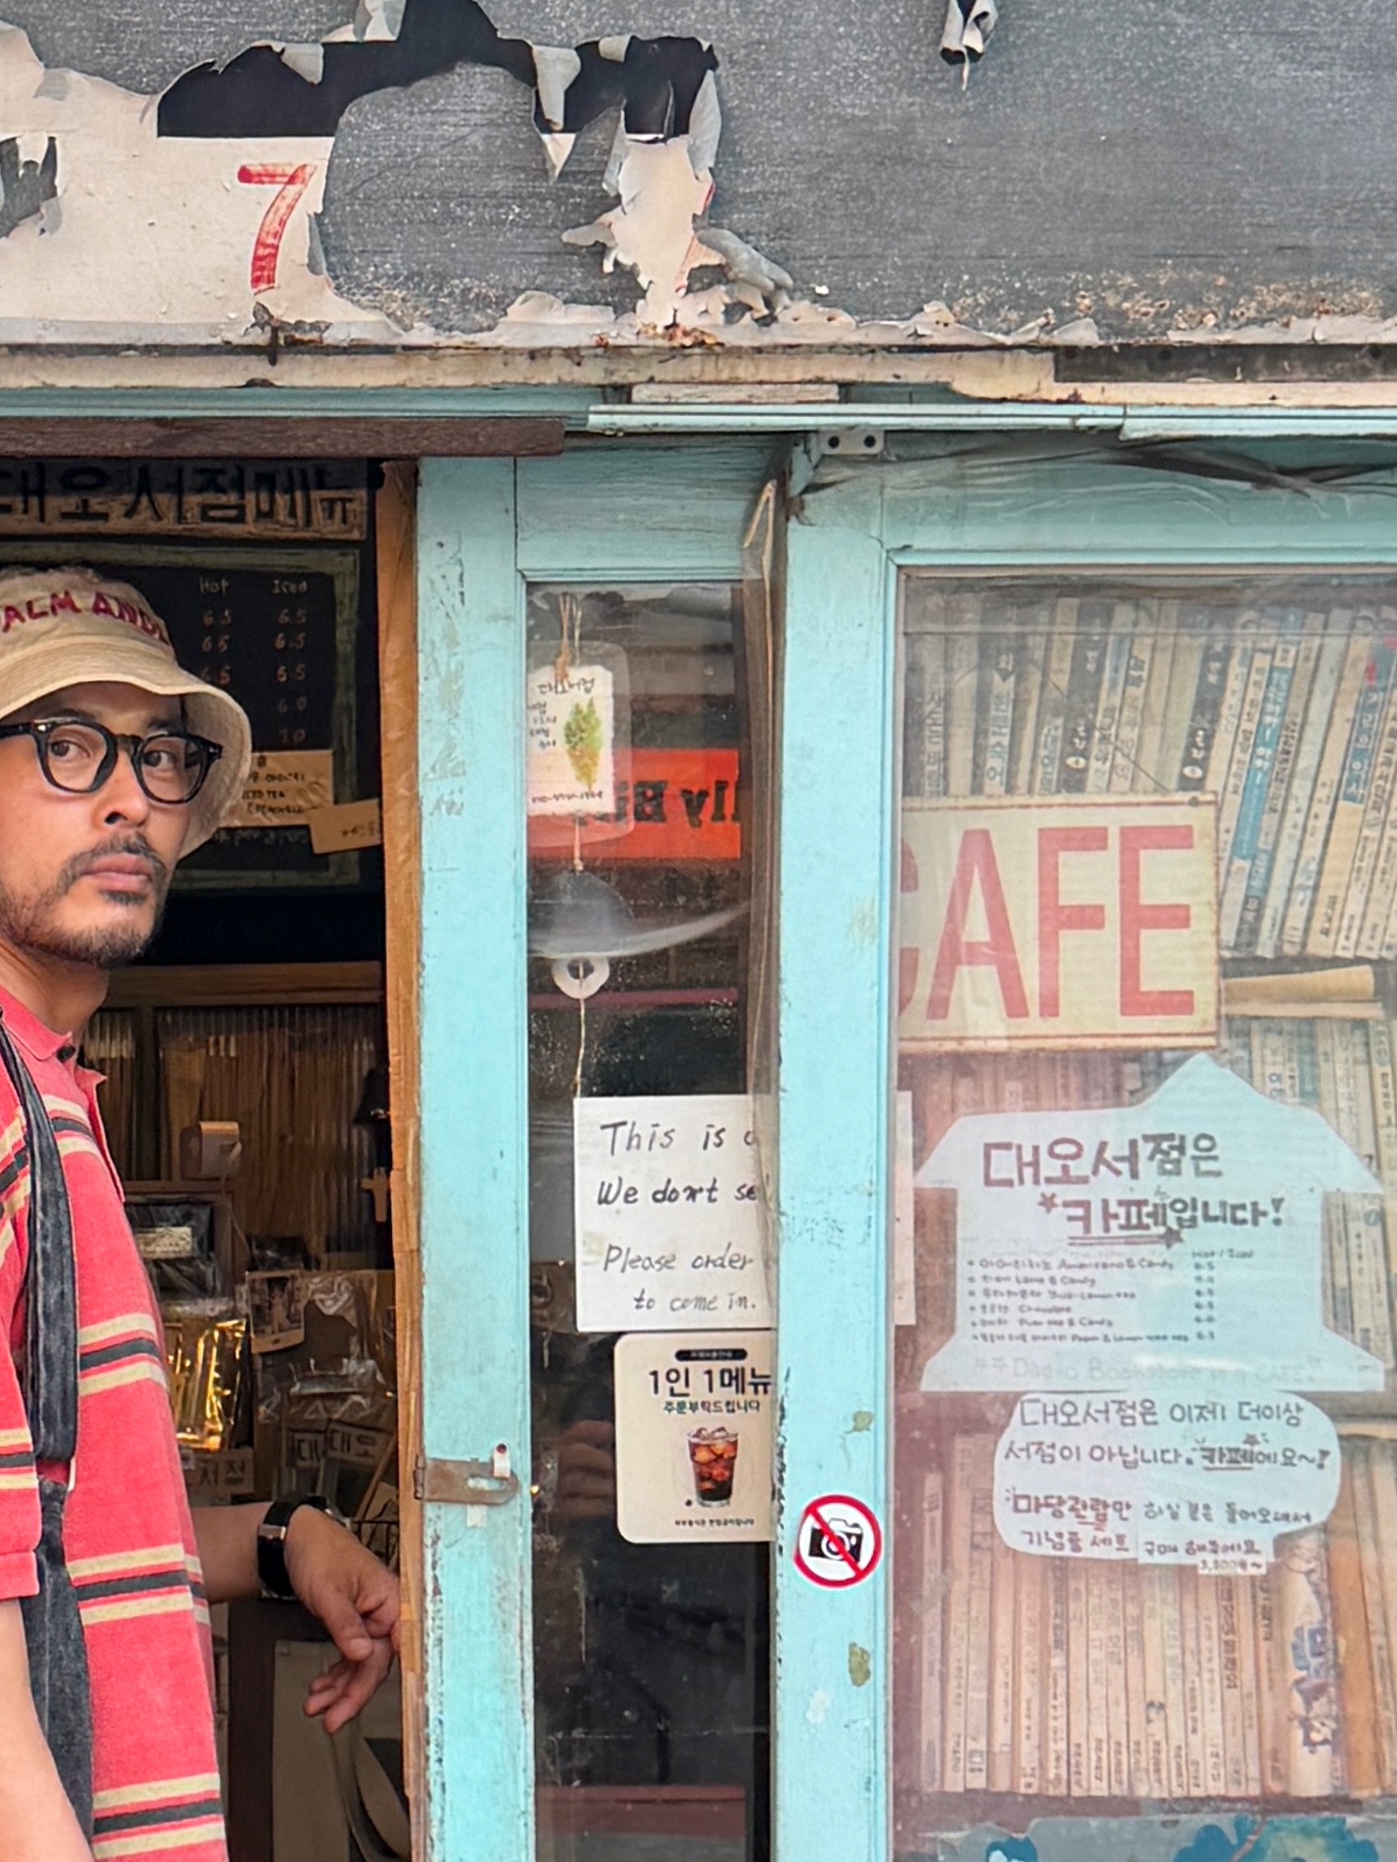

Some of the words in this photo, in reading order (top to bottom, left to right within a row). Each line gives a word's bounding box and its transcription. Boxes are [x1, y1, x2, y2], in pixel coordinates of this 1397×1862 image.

[237, 162, 314, 296] 7
[600, 1120, 676, 1156] This
[702, 1123, 727, 1150] is
[982, 1132, 1224, 1188] 대오서점은
[596, 1175, 639, 1206] We
[734, 1184, 758, 1202] se
[602, 1242, 677, 1274] Please
[690, 1242, 754, 1272] order
[633, 1288, 656, 1310] to
[669, 1295, 719, 1313] come
[702, 1366, 773, 1396] 1메뉴
[1020, 1399, 1158, 1428] 대오서점은
[1169, 1401, 1228, 1424] 이제
[1237, 1400, 1305, 1426] 더이상
[1004, 1440, 1082, 1466] 서점이
